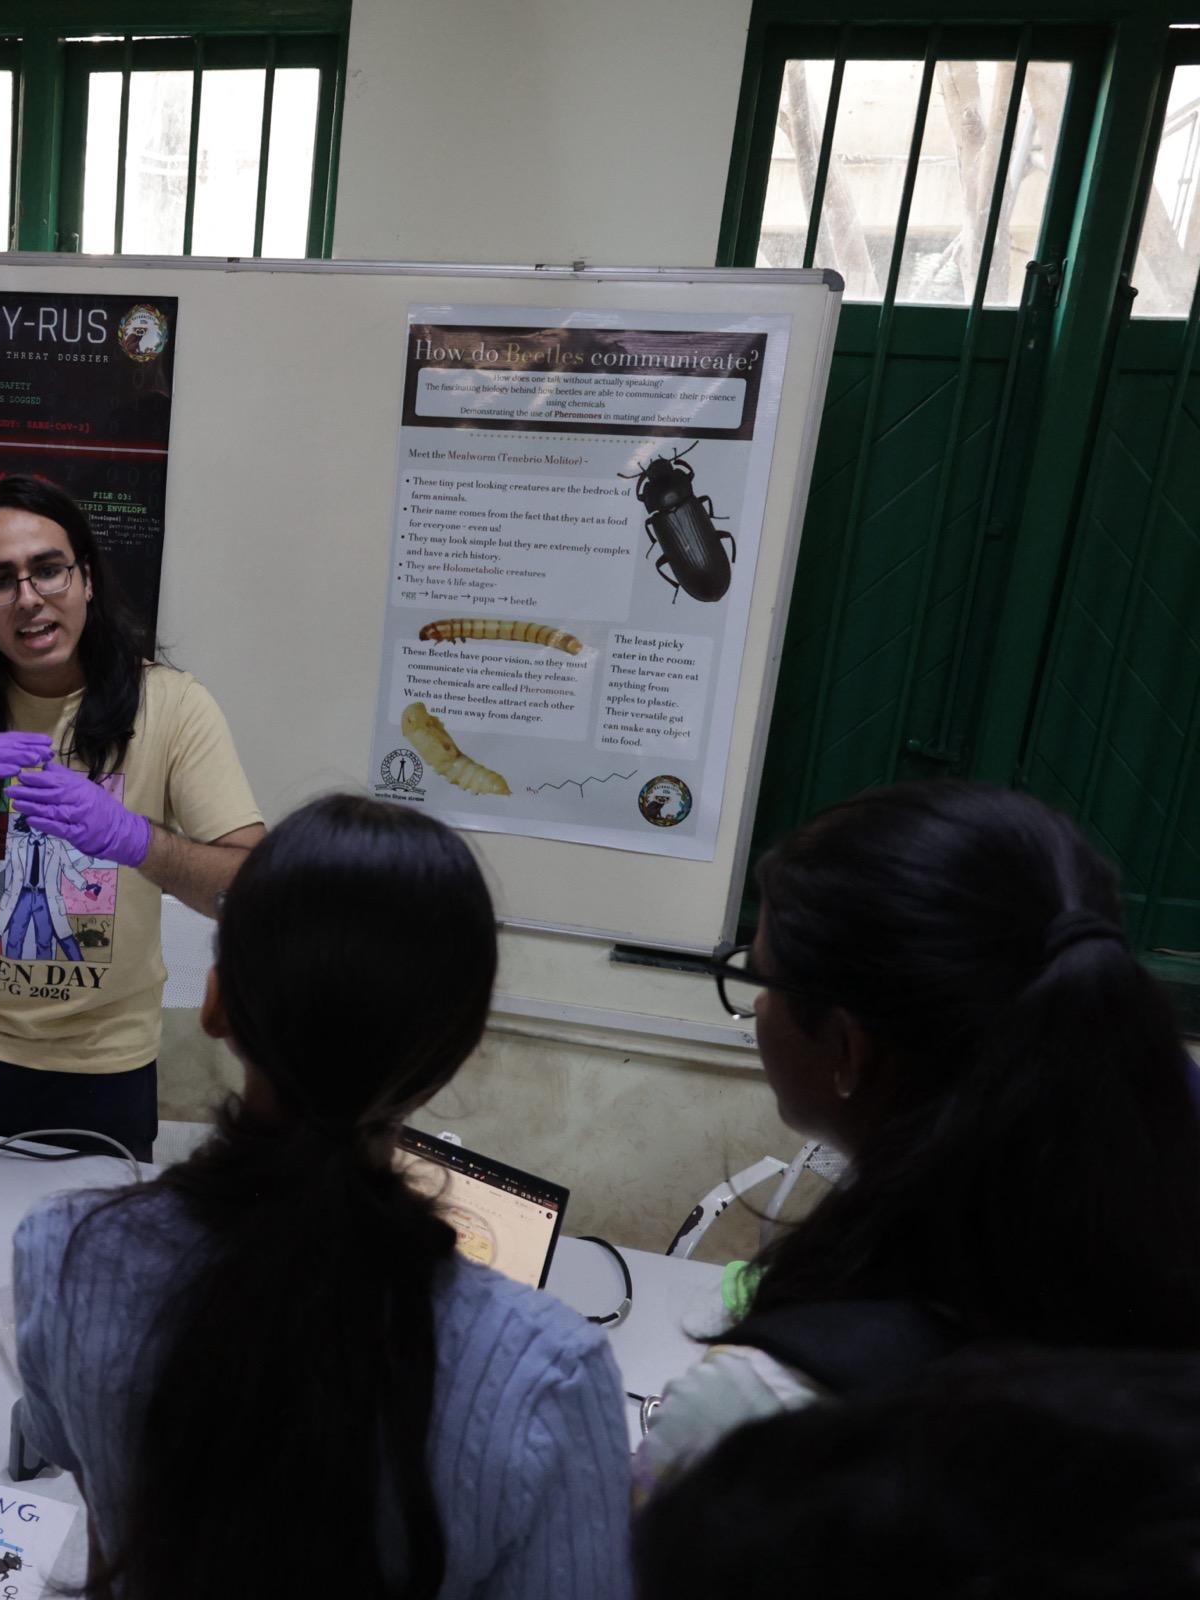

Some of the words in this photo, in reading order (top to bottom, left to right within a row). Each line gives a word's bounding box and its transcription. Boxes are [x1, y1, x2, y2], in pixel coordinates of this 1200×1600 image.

[6, 351, 48, 360] THREAT
[58, 354, 108, 363] DOSSIER
[415, 340, 464, 360] How
[472, 341, 499, 361] do
[507, 343, 583, 364] Beetles
[590, 346, 758, 370] communicate?
[461, 407, 514, 418] Demonstrating
[544, 410, 553, 418] of
[554, 411, 602, 420] Pheromones
[613, 414, 640, 423] mating
[641, 414, 656, 422] and
[658, 414, 692, 423] behavior
[409, 449, 430, 459] Meet
[432, 450, 446, 459] the
[448, 450, 496, 461] Mealworm
[413, 477, 437, 486] These
[439, 480, 454, 490] tiny
[456, 481, 473, 490] pest
[476, 480, 508, 492] looking
[509, 484, 549, 492] creatures
[568, 485, 581, 494] the
[583, 486, 619, 496] bedrock
[621, 488, 631, 496] of
[94, 492, 113, 500] FILE
[412, 491, 431, 500] farm
[433, 494, 466, 502] animals.
[107, 505, 146, 514] ENVELOPE
[410, 505, 433, 514] Their
[488, 509, 508, 518] from
[510, 511, 523, 519] the
[525, 512, 540, 520] fact
[543, 513, 560, 522] that
[561, 514, 578, 525] they
[608, 516, 628, 526] food
[408, 533, 429, 545] They
[430, 537, 447, 546] may
[449, 536, 468, 545] look
[469, 538, 496, 548] simple
[499, 538, 512, 547] but
[514, 539, 531, 551] they
[550, 544, 592, 555] extremely
[593, 546, 630, 556] complex
[406, 561, 425, 572] They
[443, 563, 504, 575] Holometabolic
[404, 574, 425, 586] They
[426, 576, 446, 585] have
[454, 578, 467, 586] life
[401, 592, 416, 600] egg
[430, 591, 458, 600] larvae
[473, 596, 495, 605] pupa
[510, 596, 537, 606] beetle
[615, 635, 632, 644] The
[635, 637, 656, 646] least
[658, 640, 684, 652] picky
[402, 646, 426, 656] These
[429, 649, 458, 658] Beetles
[460, 651, 479, 660] have
[504, 656, 532, 665] vision,
[546, 658, 564, 670] they
[612, 652, 637, 660] eater
[650, 654, 664, 663] the
[611, 665, 636, 675] These
[638, 667, 666, 677] larvae
[407, 675, 431, 684] These
[433, 678, 475, 688] chemicals
[492, 683, 518, 692] called
[609, 682, 646, 692] anything
[648, 683, 669, 693] from
[606, 708, 629, 717] Their
[630, 712, 668, 721] versatile
[669, 716, 683, 724] gut
[45, 965, 109, 989] DAY
[29, 986, 71, 1001] 2026
